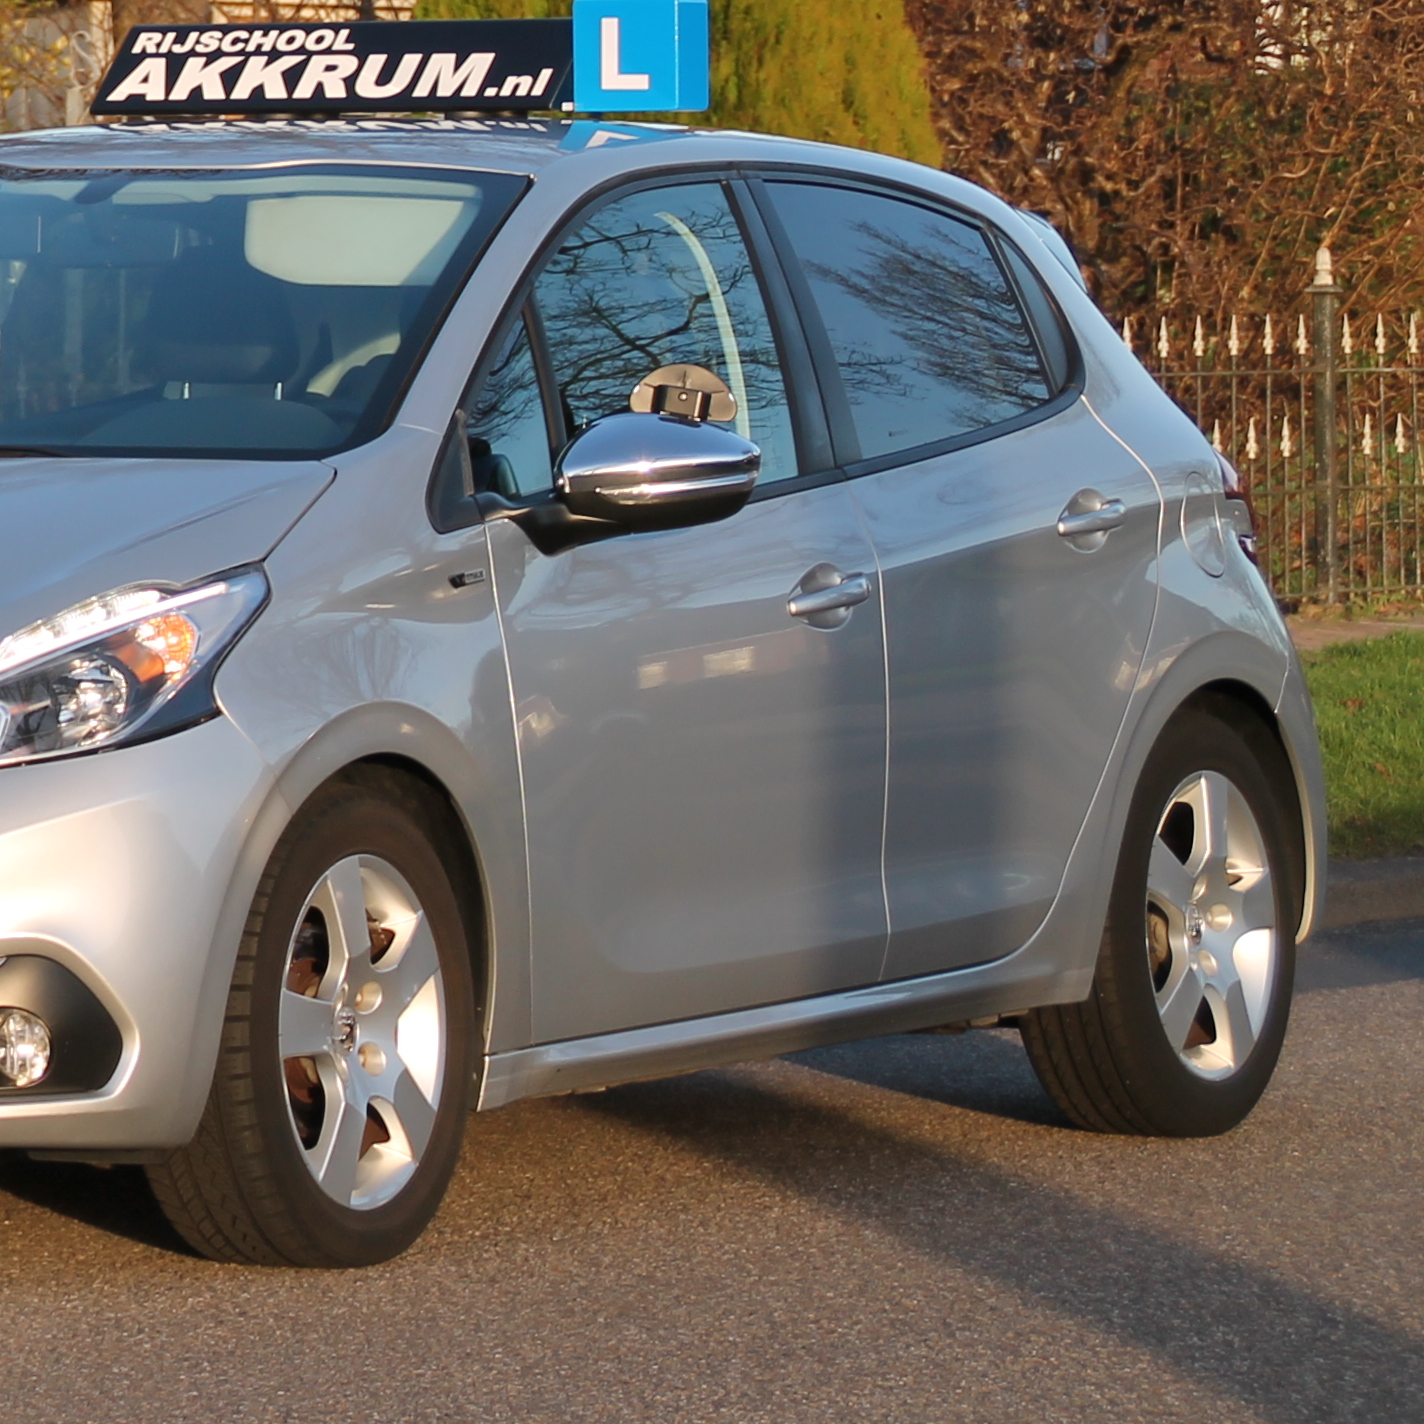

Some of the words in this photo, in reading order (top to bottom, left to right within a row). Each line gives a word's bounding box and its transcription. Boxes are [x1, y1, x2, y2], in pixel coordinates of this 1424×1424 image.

[131, 29, 355, 54] RIJSCHOOL
[600, 16, 650, 91] L
[106, 52, 553, 102] AKKRUM.nl
